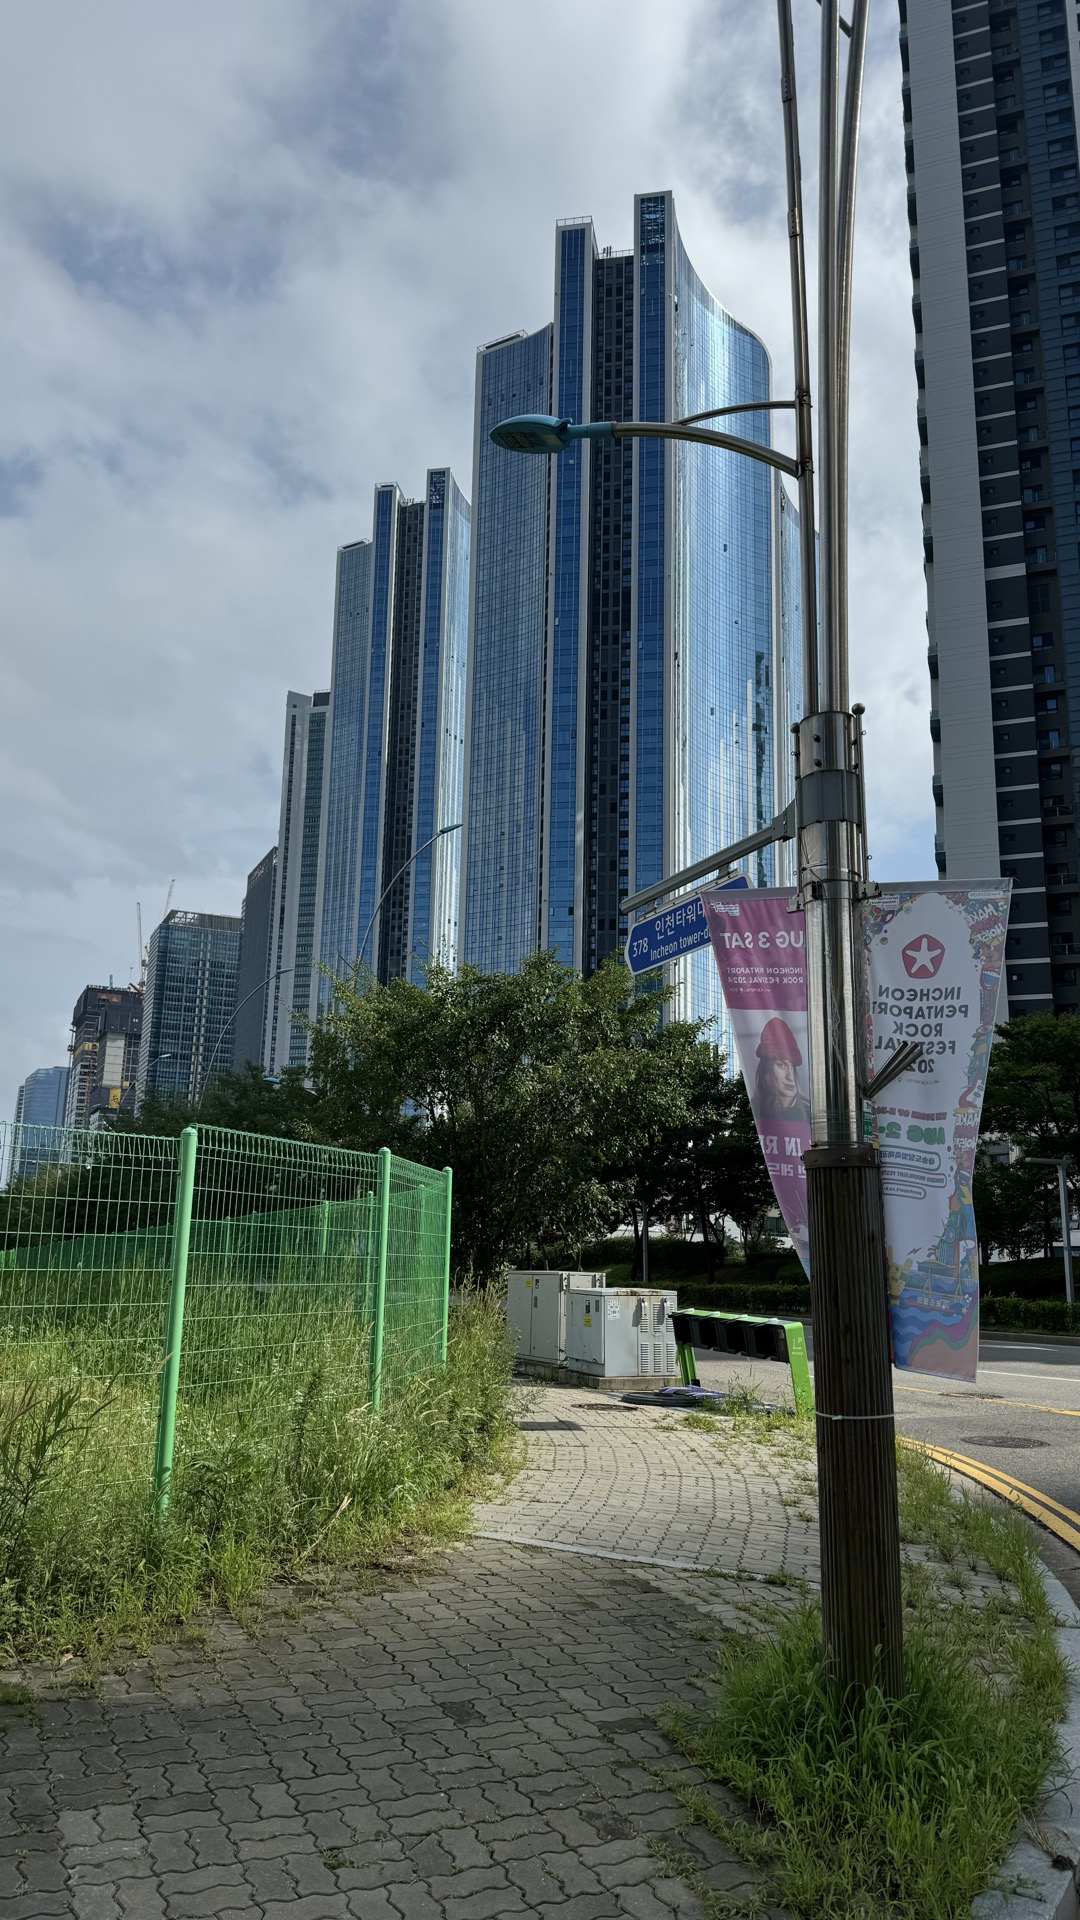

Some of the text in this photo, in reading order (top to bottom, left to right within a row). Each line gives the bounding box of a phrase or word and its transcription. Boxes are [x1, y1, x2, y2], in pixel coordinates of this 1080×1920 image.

[632, 937, 649, 958] 378
[650, 928, 709, 962] Incheon tower-d
